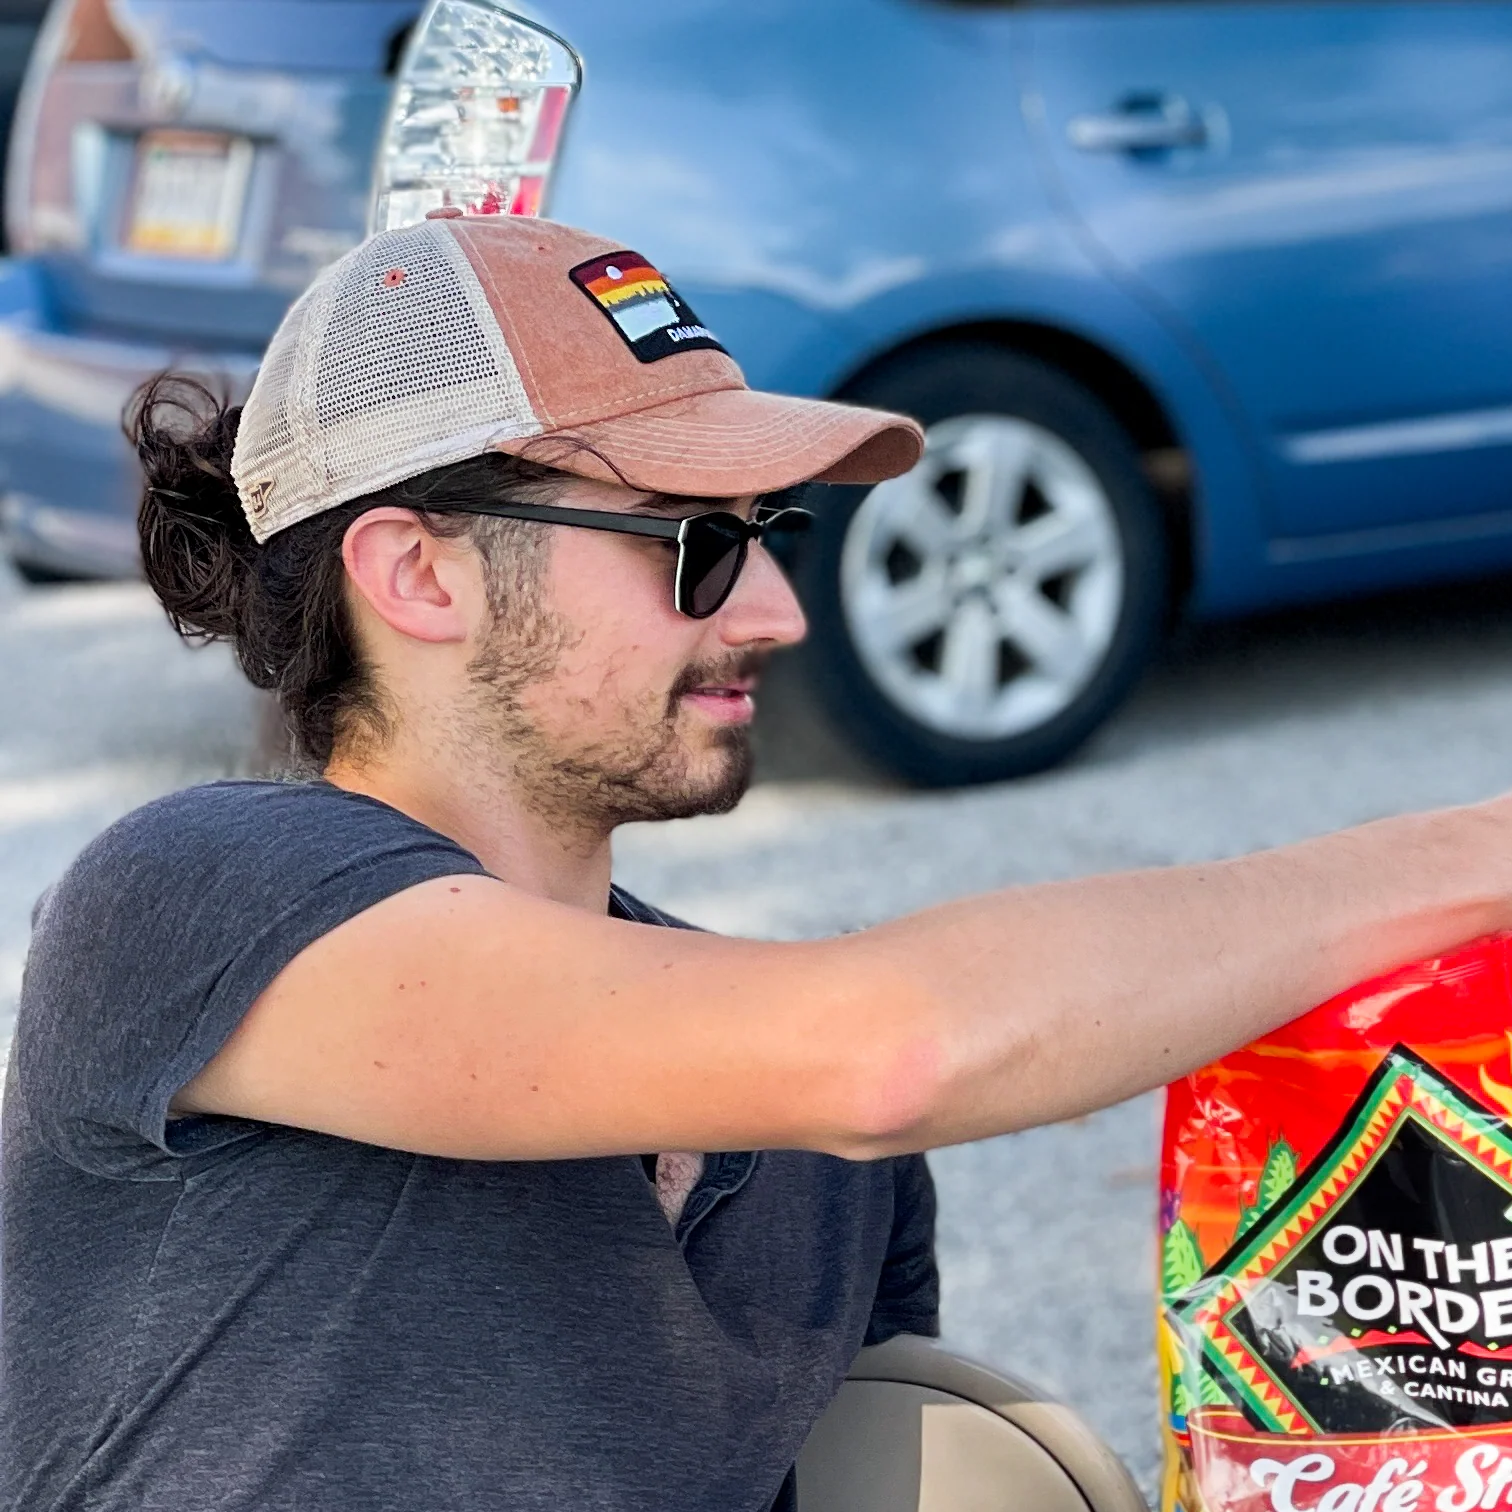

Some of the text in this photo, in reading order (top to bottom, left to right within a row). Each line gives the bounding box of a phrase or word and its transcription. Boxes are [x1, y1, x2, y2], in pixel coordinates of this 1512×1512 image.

[1322, 1225, 1402, 1271] ON
[1331, 1355, 1467, 1385] MEXICAN
[1379, 1381, 1509, 1407] & CANTINA
